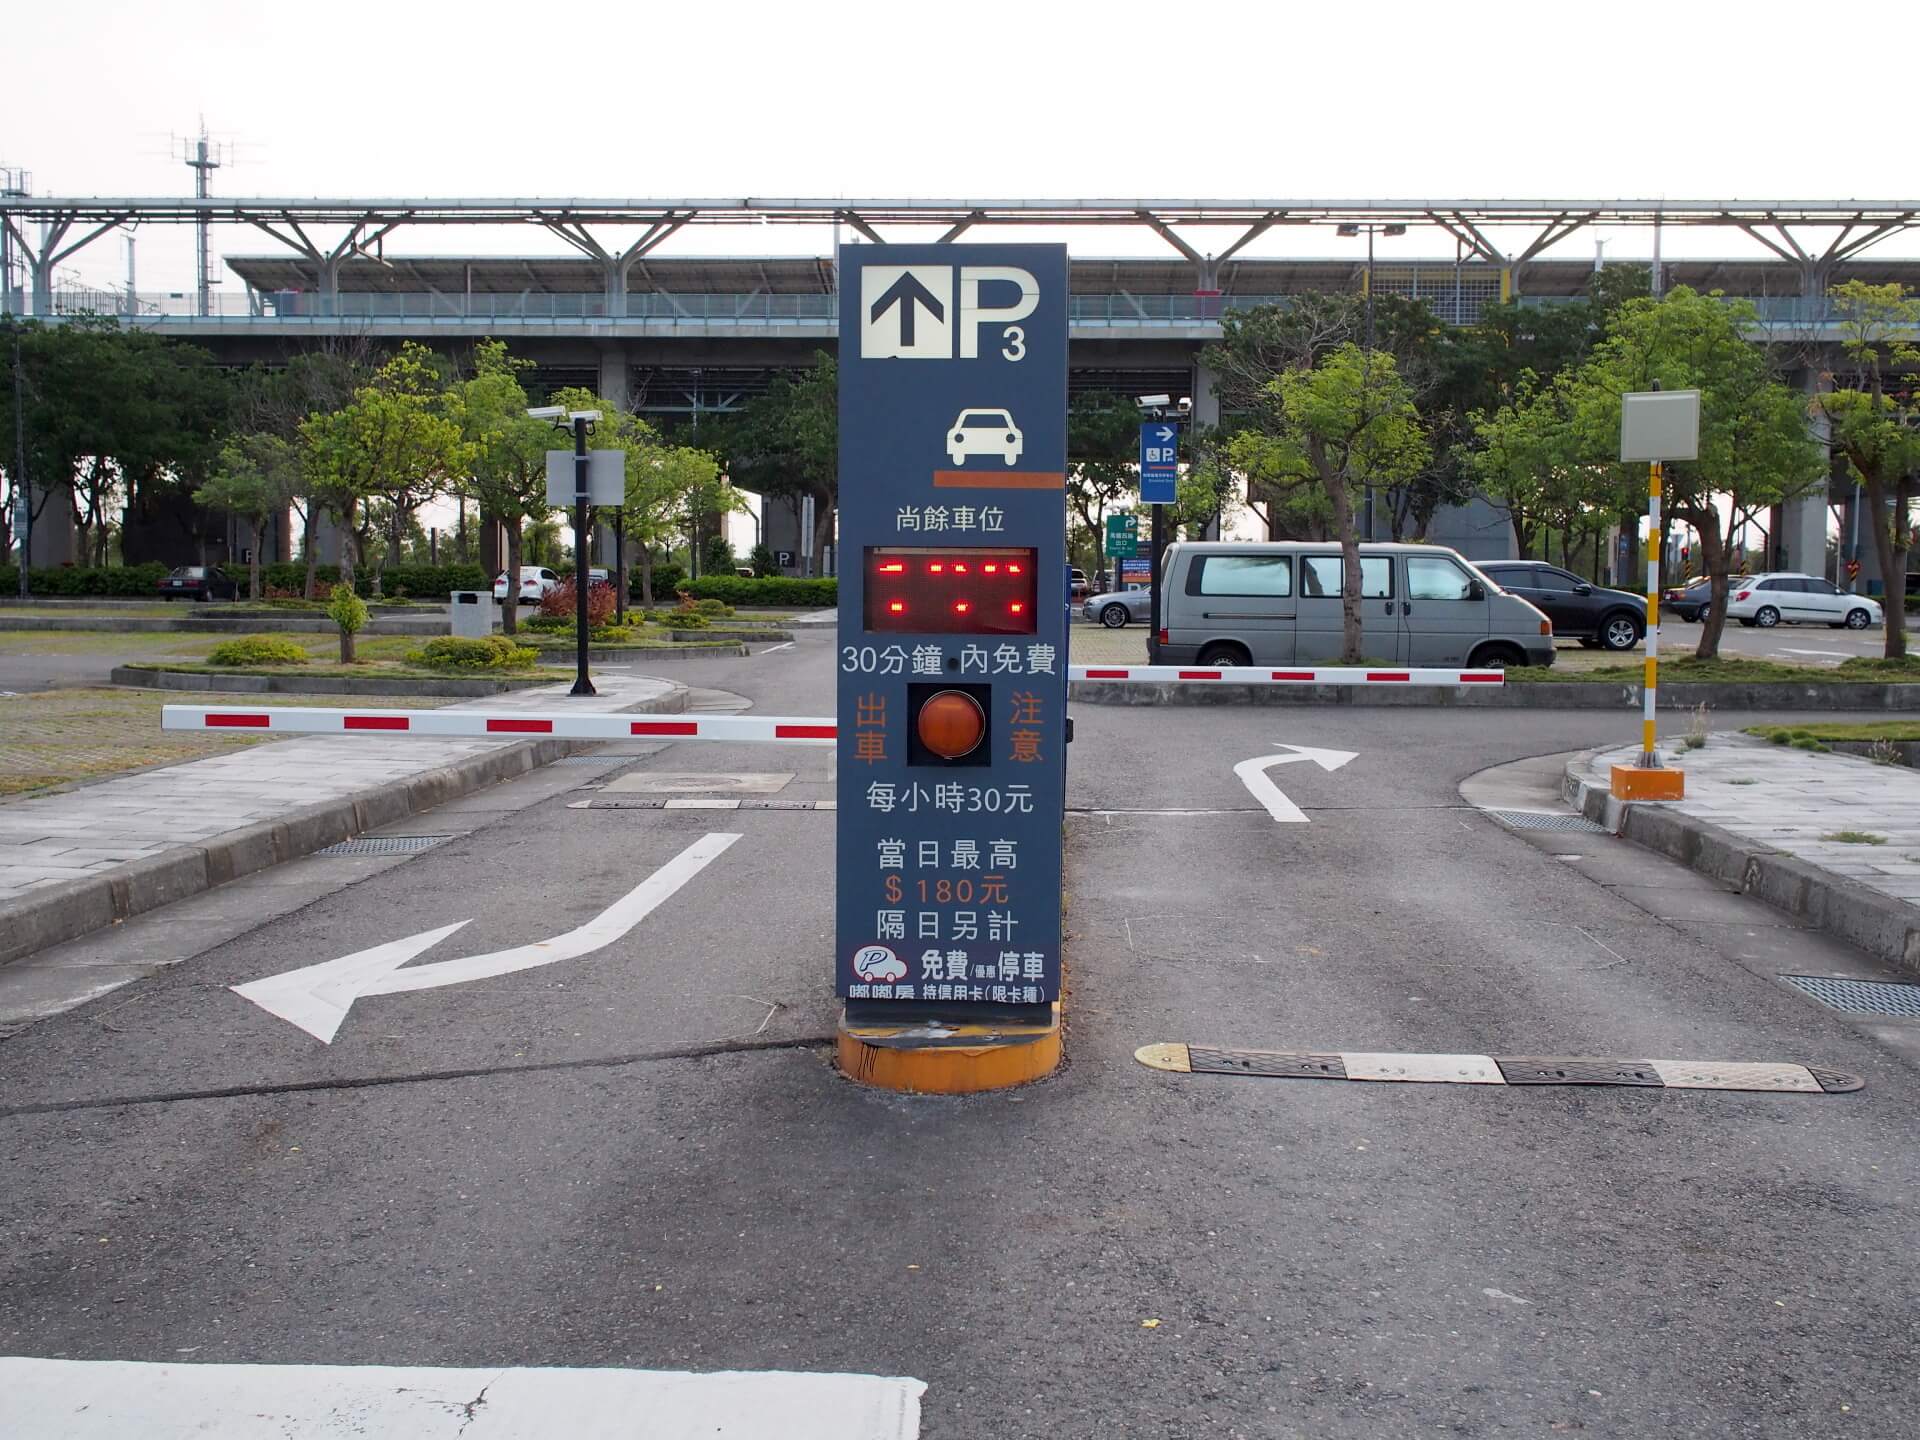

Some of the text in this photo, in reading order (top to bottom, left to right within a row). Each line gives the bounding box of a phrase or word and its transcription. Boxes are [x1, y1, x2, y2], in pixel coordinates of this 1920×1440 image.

[1163, 448, 1174, 462] P
[897, 505, 1005, 532] 尚餘車位
[842, 644, 943, 675] 30分鐘
[854, 692, 888, 765] 出車
[1009, 691, 1043, 763] 注意
[866, 780, 1034, 814] 每小時30元
[877, 838, 1018, 870] 當日最高
[876, 909, 1019, 941] 隔日另計
[849, 984, 915, 1000] 嘟嘟房
